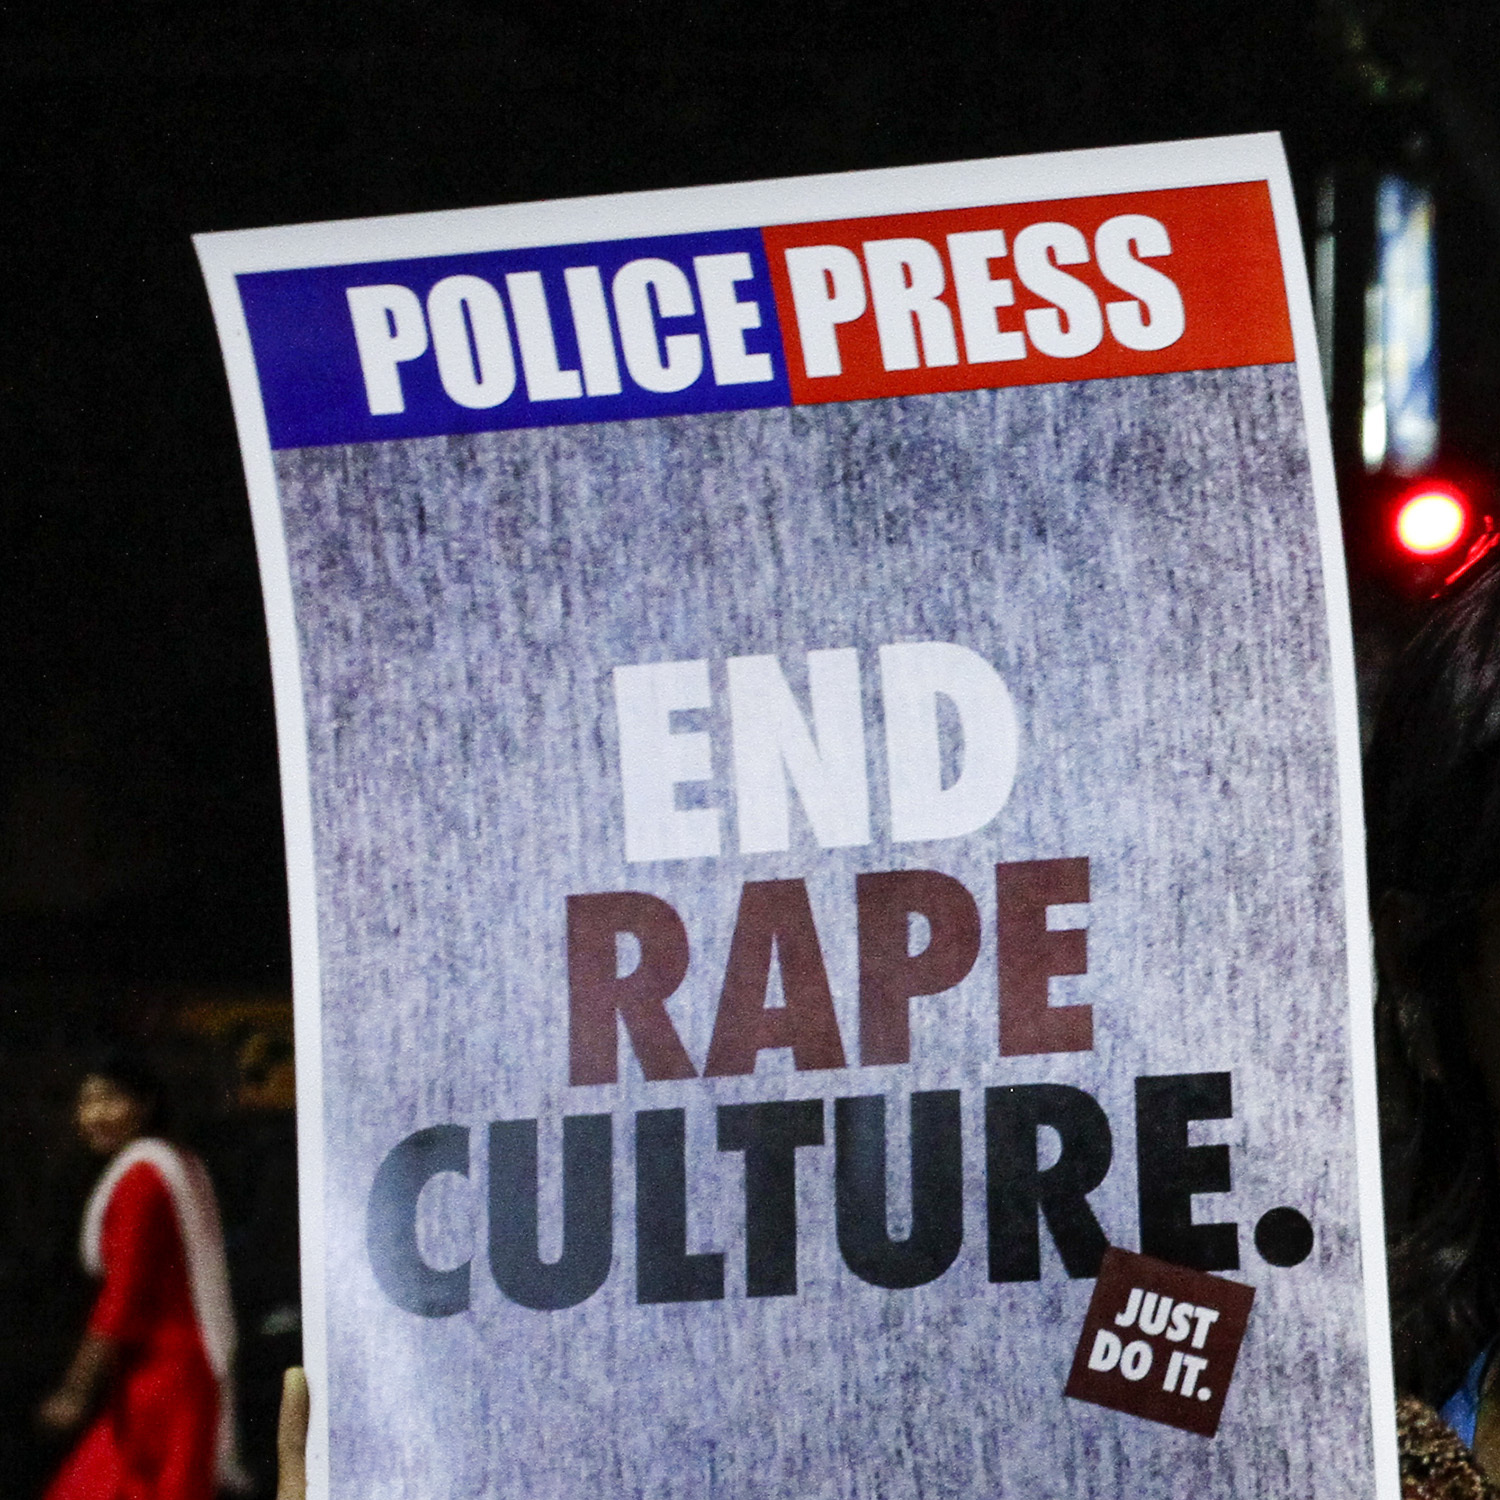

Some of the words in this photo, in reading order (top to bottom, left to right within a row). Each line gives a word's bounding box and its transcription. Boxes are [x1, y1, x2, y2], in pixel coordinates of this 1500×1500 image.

[344, 249, 774, 417] POLICE
[784, 213, 1187, 379] PRESS
[612, 640, 1021, 863] END
[565, 856, 1095, 1087] RAPE
[365, 1070, 1316, 1319] CULTURE.
[1087, 1328, 1154, 1382] DO
[1161, 1350, 1213, 1402] IT.
[1114, 1287, 1221, 1350] JUST
